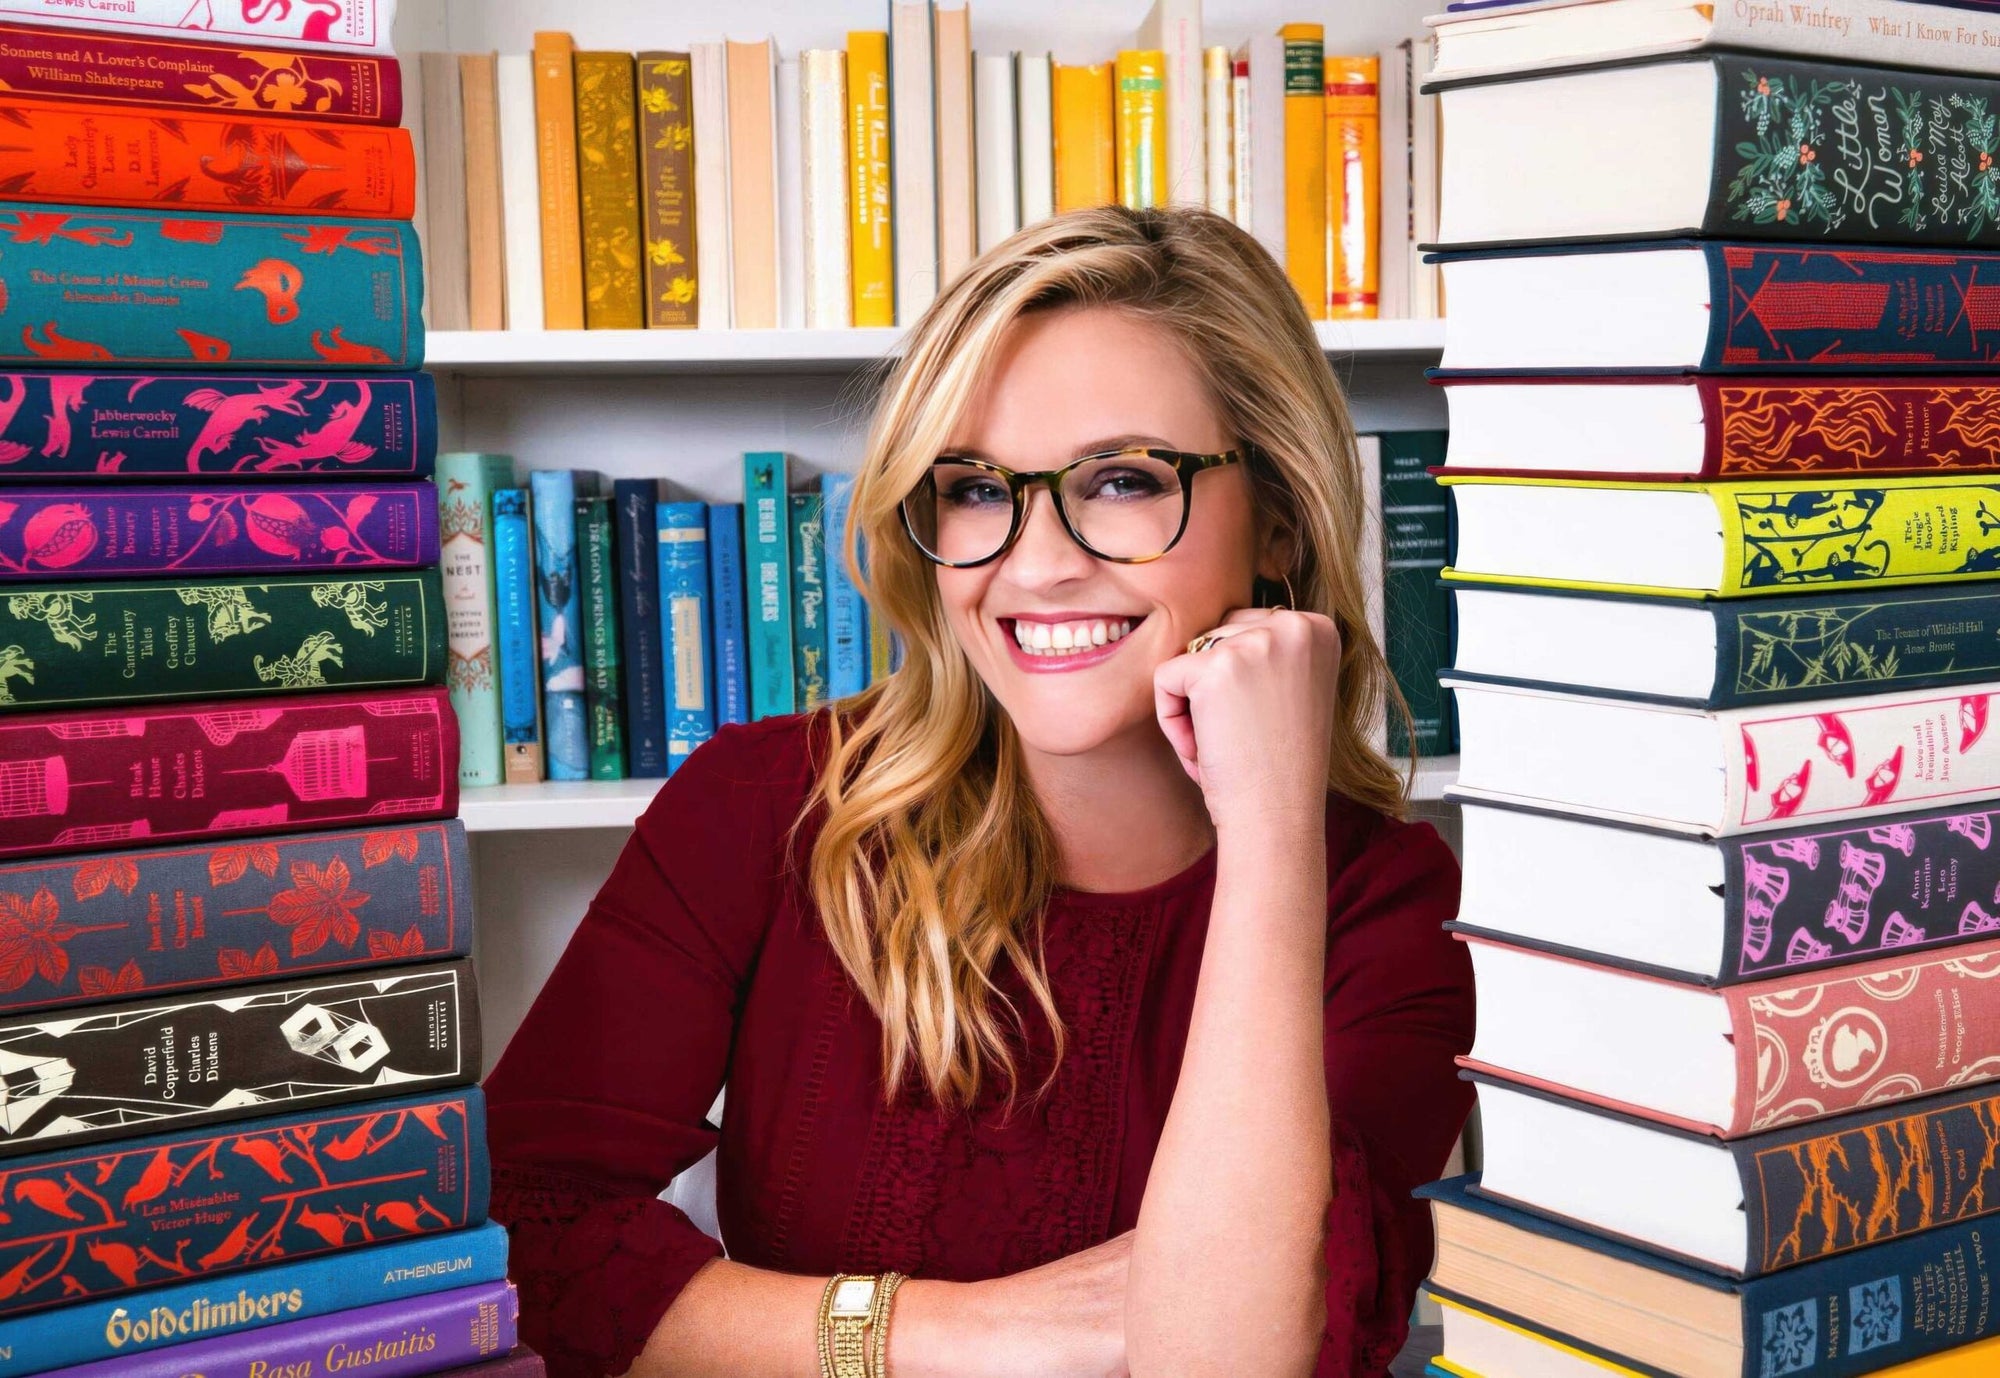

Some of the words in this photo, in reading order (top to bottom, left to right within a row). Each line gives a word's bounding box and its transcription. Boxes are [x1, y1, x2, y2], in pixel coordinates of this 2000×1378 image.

[88, 0, 135, 12] Carroll
[1734, 0, 1784, 23] Oprah
[1791, 7, 1851, 34] Winfrey
[1869, 17, 1902, 37] What
[1906, 22, 1912, 38] I
[1917, 24, 1953, 42] Know
[1957, 27, 1978, 45] For
[0, 43, 53, 60] Sonnets
[55, 50, 80, 63] and
[83, 52, 94, 64] A
[98, 52, 145, 68] Lover's
[147, 56, 215, 75] Complaint
[27, 65, 82, 83] William
[85, 71, 164, 90] Shakespeare
[351, 65, 359, 112] PENGUIN
[363, 65, 371, 114] CLASSICS
[1928, 94, 1952, 154] May
[64, 133, 80, 169] Lady
[102, 133, 116, 174] Lover
[146, 128, 159, 188] Lawrence
[1833, 97, 1871, 214] Little
[1868, 87, 1902, 229] Women
[1950, 124, 1971, 199] Alcott
[1932, 153, 1955, 225] Louisa
[31, 269, 56, 284] The
[61, 272, 102, 286] Count
[106, 273, 119, 286] of
[122, 275, 166, 288] Monte
[169, 276, 209, 290] Cristo
[63, 291, 129, 305] Alexandre
[133, 293, 180, 306] Dumas
[91, 408, 177, 425] Jabberwocky
[91, 426, 129, 440] Lewis
[132, 426, 180, 440] Carroll
[383, 403, 391, 452] PENGUIN
[1904, 401, 1914, 430] Iliad
[1920, 407, 1930, 450] Homer
[1904, 431, 1914, 456] The
[105, 506, 117, 559] Madame
[125, 510, 139, 555] Bovary
[149, 506, 160, 557] Gustave
[167, 505, 178, 558] Flaubert
[758, 498, 776, 543] BEHOLD
[1905, 519, 1913, 543] The
[1913, 512, 1924, 551] Jungle
[1924, 511, 1932, 549] Books
[1937, 504, 1949, 555] Rudyard
[1950, 507, 1960, 552] Kipling
[446, 564, 482, 577] NEST
[588, 523, 602, 583] DRAGON
[798, 521, 821, 584] Beautiful
[508, 557, 520, 628] PATCHETT
[760, 562, 779, 622] DREAMERS
[802, 587, 823, 629] Ruins
[394, 608, 402, 655] PENGUIN
[592, 586, 605, 647] SPRINGS
[1875, 629, 1893, 641] The
[1894, 626, 1920, 639] Tenant
[1921, 625, 1931, 637] of
[1931, 622, 1965, 637] Wildfell
[1965, 620, 1984, 633] Hall
[104, 631, 117, 658] The
[122, 609, 138, 680] Canterbury
[141, 627, 153, 660] Tales
[166, 614, 181, 671] Geoffrey
[184, 615, 196, 667] Chaucer
[724, 638, 735, 672] ALICE
[1904, 643, 1925, 655] Anne
[596, 649, 608, 690] ROAD
[595, 705, 605, 746] CHANG
[606, 708, 615, 742] JANIE
[1912, 724, 1922, 747] and
[1939, 714, 1950, 755] Austen
[147, 757, 161, 799] House
[173, 752, 187, 800] Charles
[192, 748, 204, 799] Dickens
[411, 732, 419, 780] PENGUIN
[1914, 750, 1924, 779] Love
[1940, 757, 1950, 783] Jane
[129, 761, 144, 798] Bleak
[1911, 869, 1921, 901] Anna
[1920, 856, 1932, 910] Karenina
[1937, 869, 1946, 893] Leo
[1947, 857, 1959, 903] Tolstoy
[440, 1000, 448, 1050] CLASSICS
[1950, 987, 1962, 1020] Eliot
[1935, 988, 1946, 1071] Middlemarch
[1951, 1019, 1966, 1065] George
[143, 1045, 157, 1086] David
[162, 1025, 178, 1100] Copperfield
[188, 1034, 201, 1084] Charles
[206, 1031, 219, 1083] Dickens
[1935, 1119, 1951, 1215] Metamorphoses
[1957, 1149, 1967, 1182] Ovid
[142, 1204, 167, 1219] Les
[150, 1214, 191, 1233] Victor
[195, 1209, 233, 1231] Hugo
[383, 1256, 473, 1284] ATHENEUM
[1971, 1230, 1985, 1269] TWO
[1911, 1274, 1924, 1330] JENNIE
[1922, 1262, 1933, 1300] LIFE
[1934, 1264, 1946, 1308] LADY
[1944, 1251, 1957, 1336] RANDOLPH
[1954, 1243, 1969, 1336] CHURCHILL
[105, 1287, 304, 1349] Goldclimbers
[1925, 1302, 1936, 1335] THE
[1936, 1311, 1946, 1330] OF
[1974, 1272, 1991, 1336] VOLUME
[469, 1317, 478, 1348] HOLT
[478, 1300, 489, 1357] RINEHART
[488, 1303, 500, 1355] WINSTON
[1826, 1294, 1839, 1360] MARTIN
[248, 1357, 313, 1378] Rasa
[325, 1327, 437, 1370] Gustaitis
